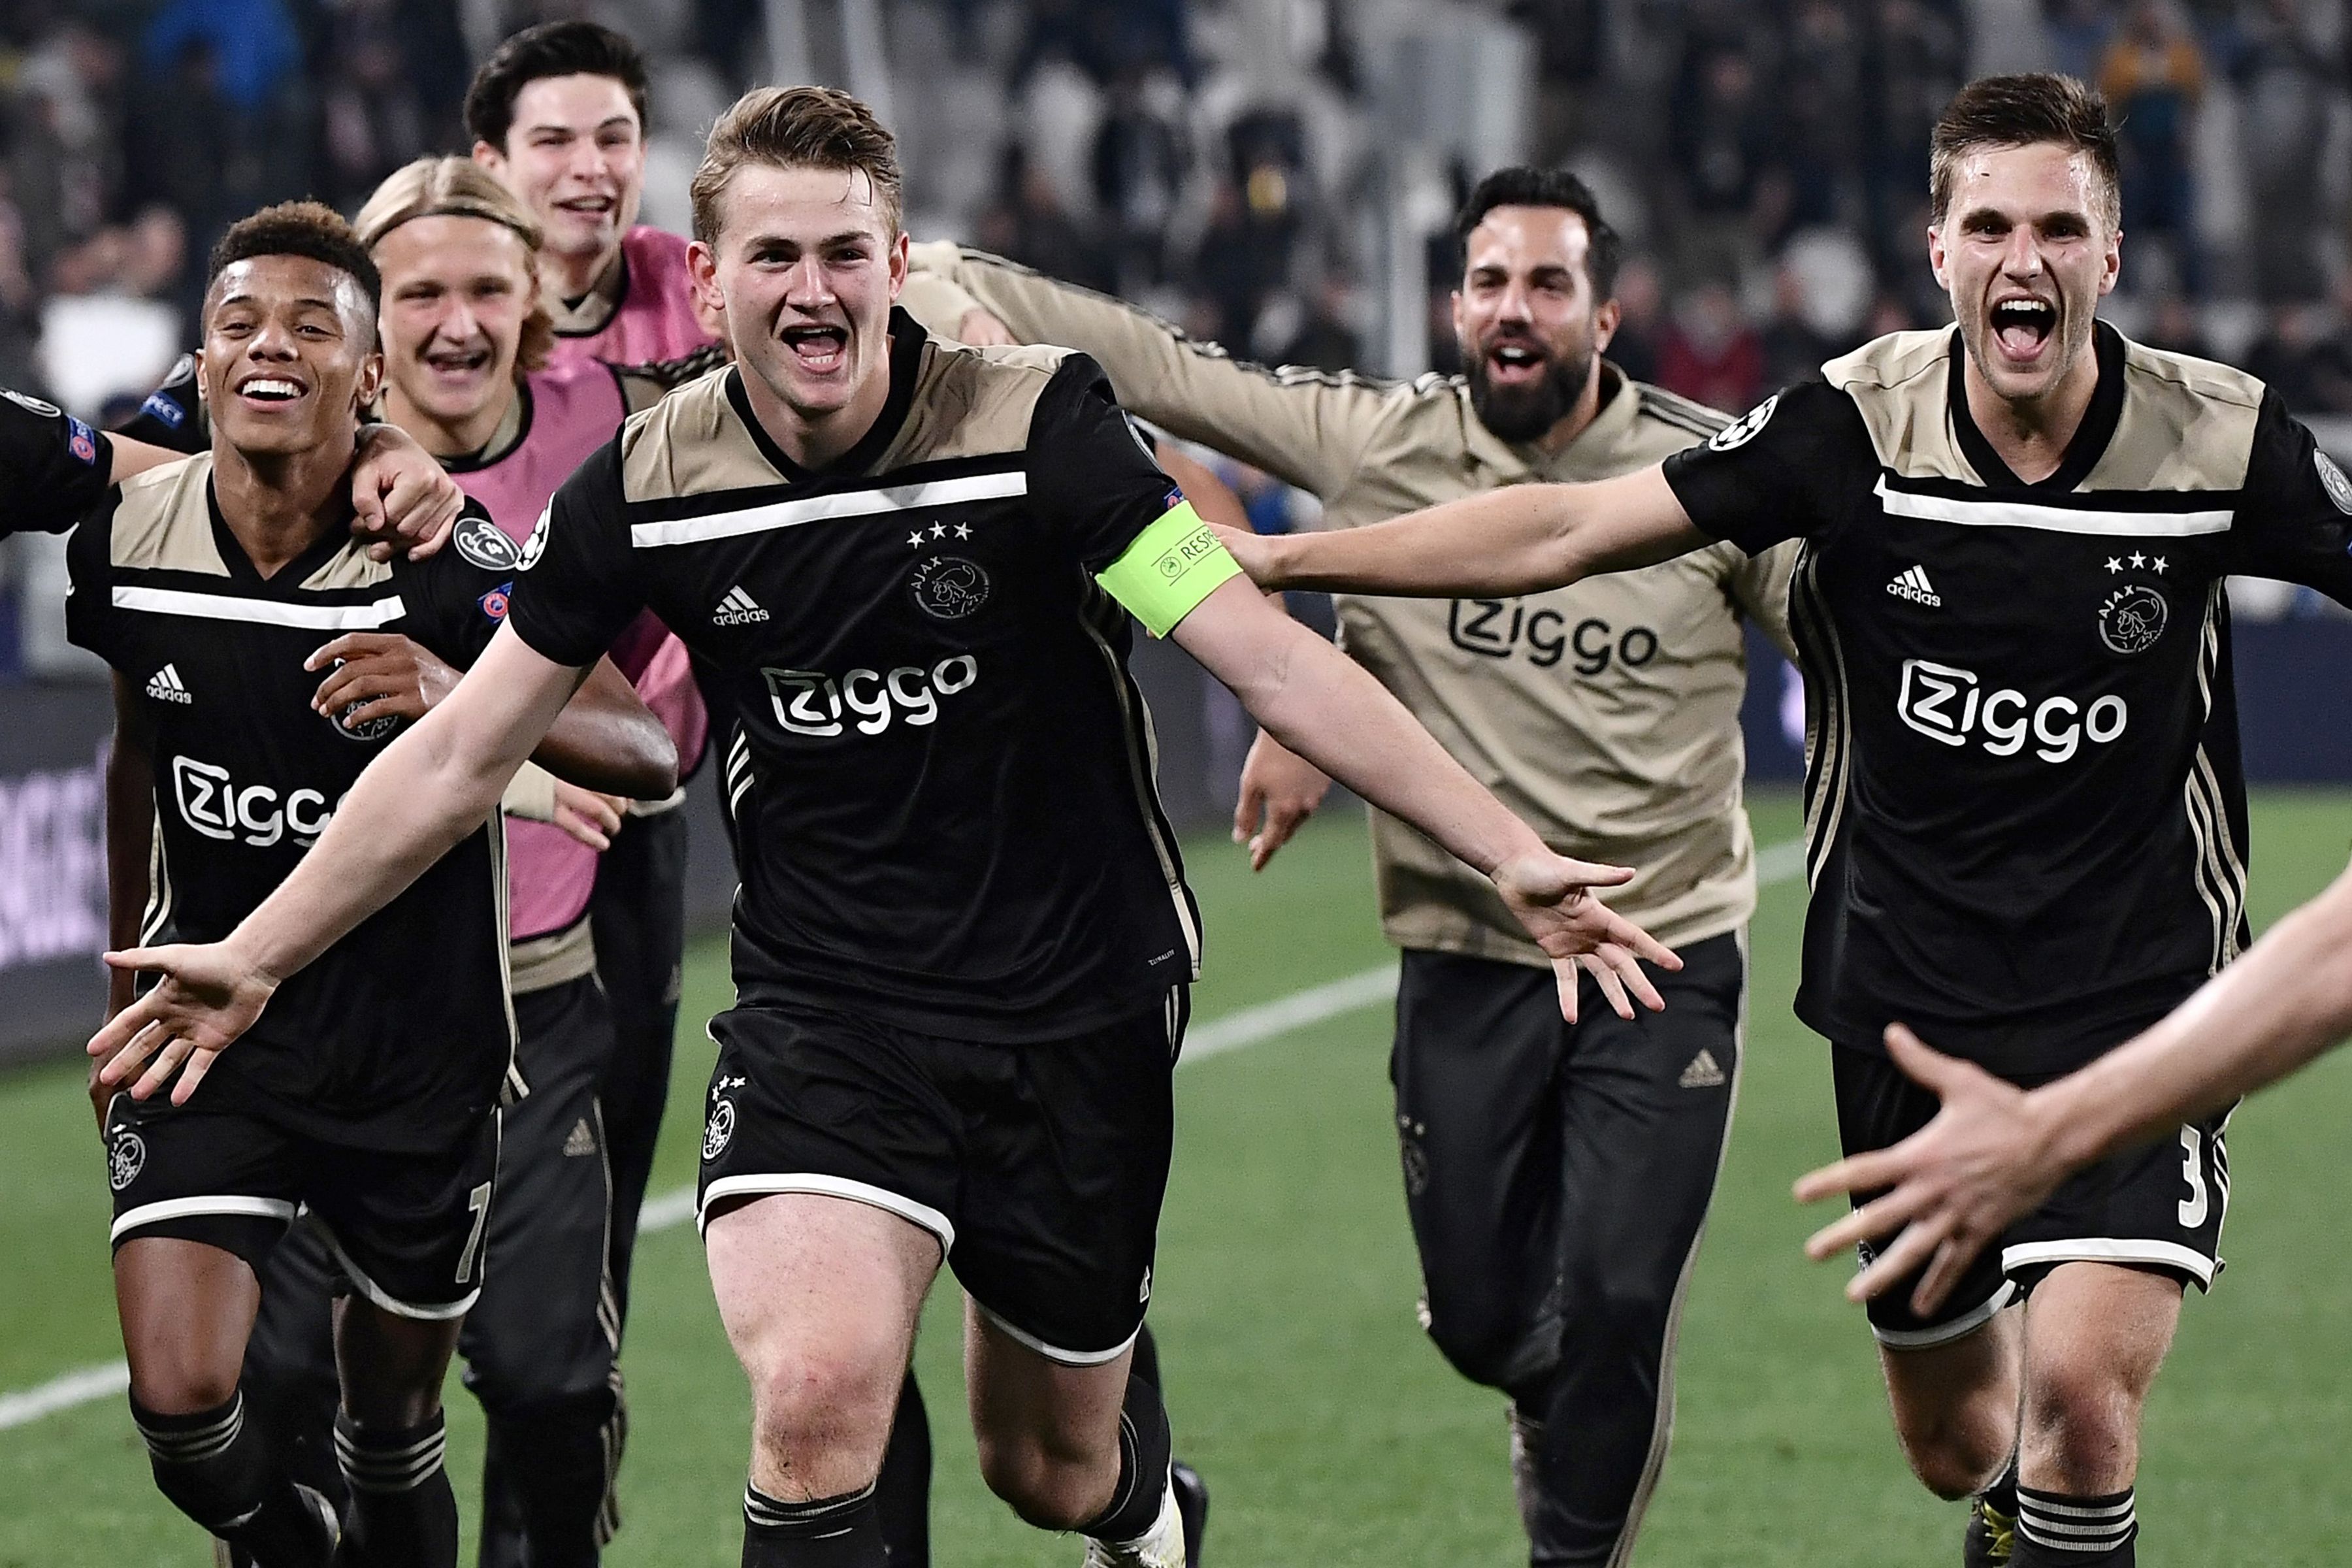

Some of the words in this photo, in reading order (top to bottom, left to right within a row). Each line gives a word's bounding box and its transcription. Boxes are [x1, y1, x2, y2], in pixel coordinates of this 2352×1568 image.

[911, 556, 942, 590] AJAX
[1886, 583, 1941, 607] adidas
[2098, 584, 2134, 619] AJAX
[713, 609, 770, 626] adidas
[146, 685, 192, 704] adidas
[172, 755, 350, 847] Zigg
[2178, 1123, 2208, 1229] 3
